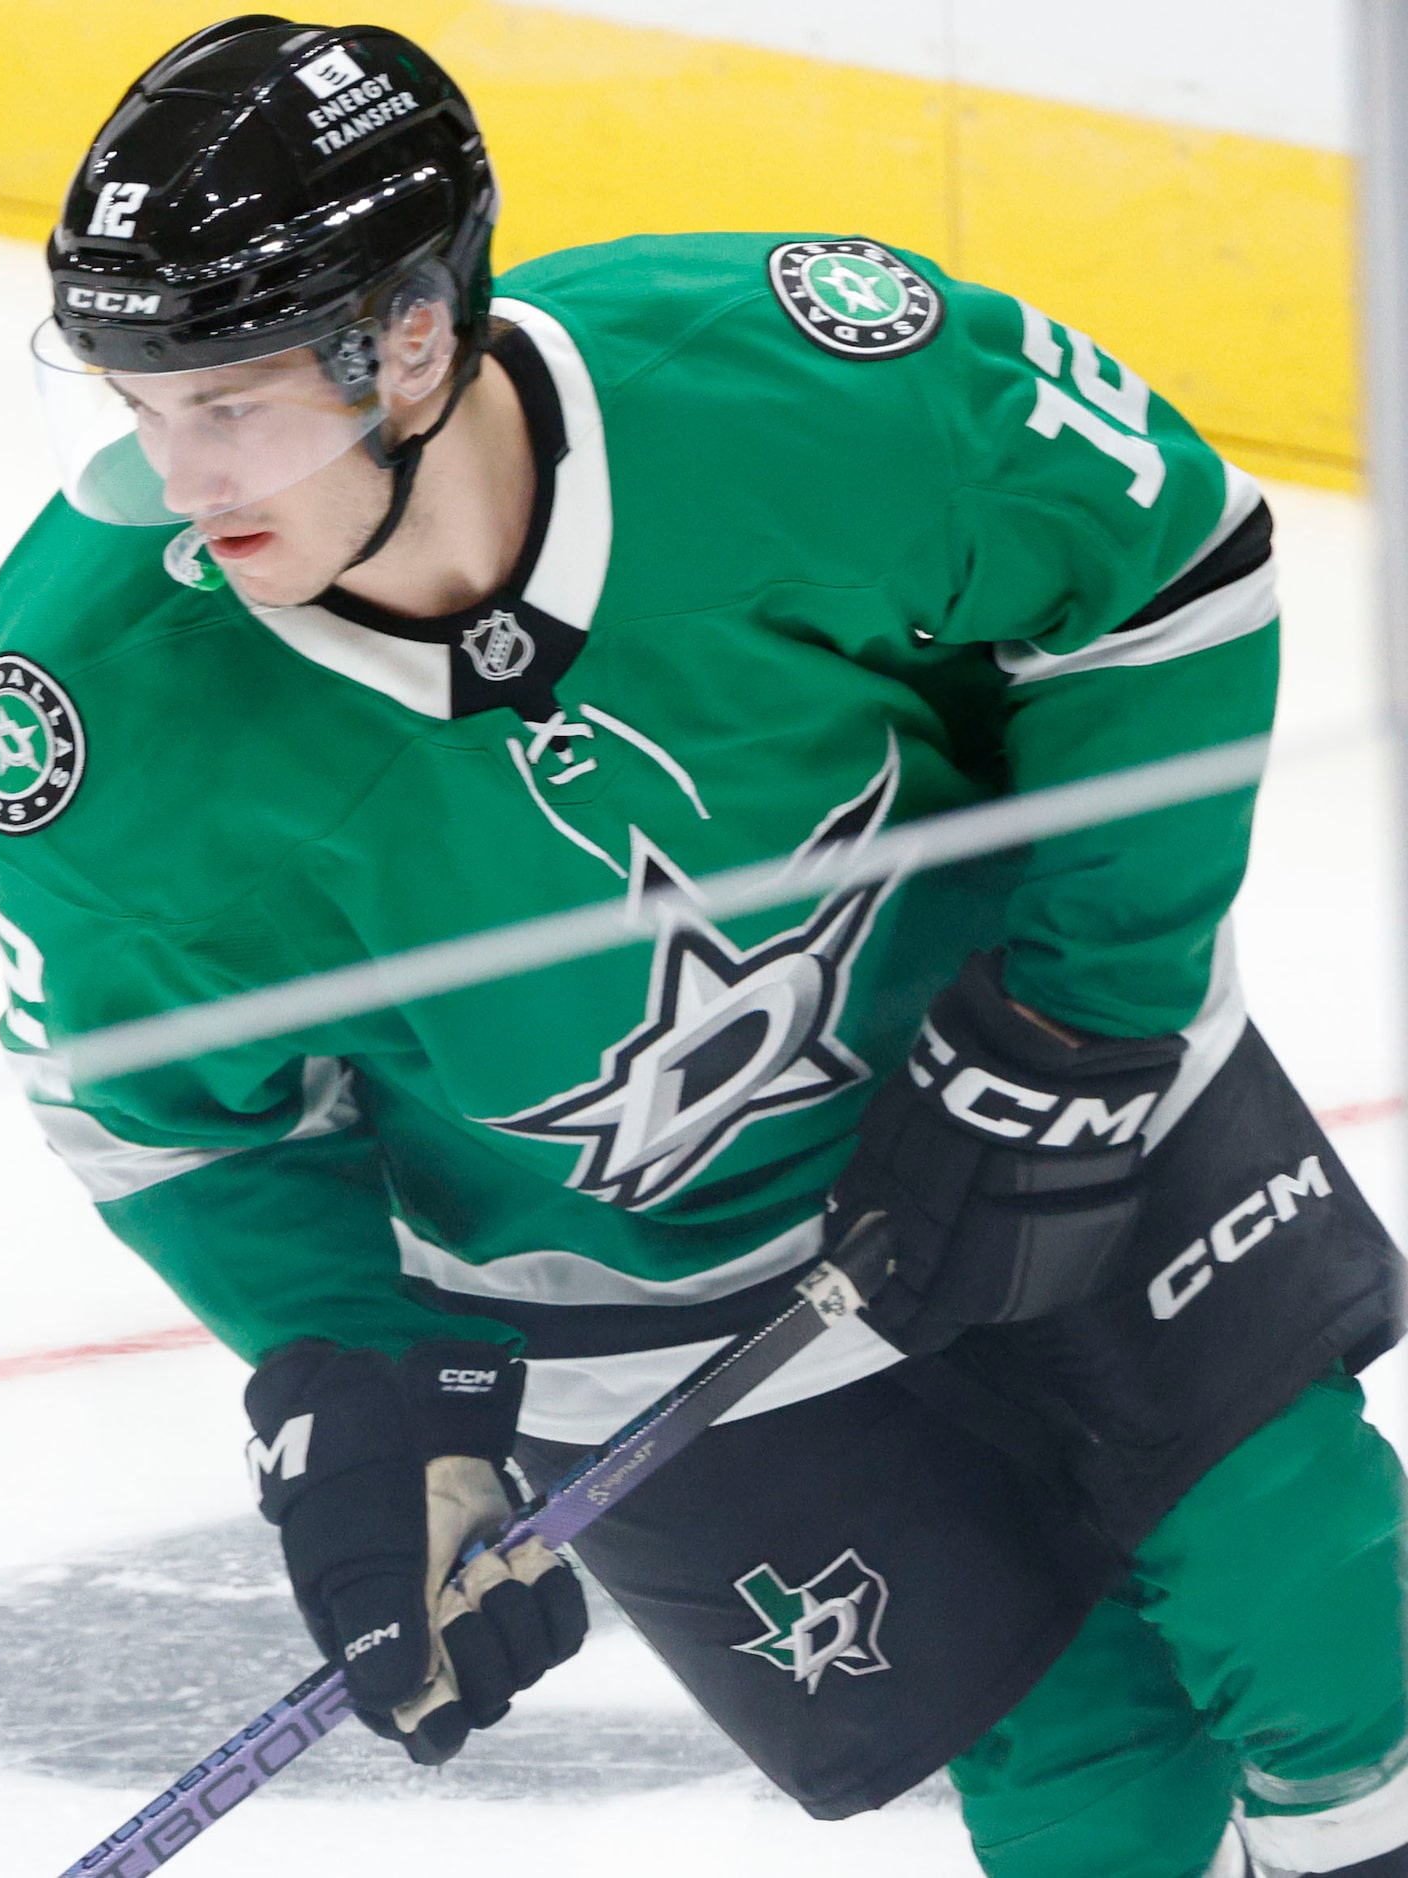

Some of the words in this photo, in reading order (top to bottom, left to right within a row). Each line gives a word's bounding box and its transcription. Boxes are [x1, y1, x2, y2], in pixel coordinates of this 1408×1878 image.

[307, 73, 394, 129] ENERGY
[312, 92, 420, 154] TRANSFER
[88, 182, 150, 238] 12
[66, 287, 161, 316] CCM
[1017, 298, 1167, 509] 12
[908, 1013, 1159, 1147] CCM
[1147, 1155, 1333, 1320] CCM
[438, 1368, 497, 1385] CCM
[245, 1412, 314, 1502] M
[344, 1622, 400, 1661] CCM
[96, 1685, 350, 1877] IBCOR
